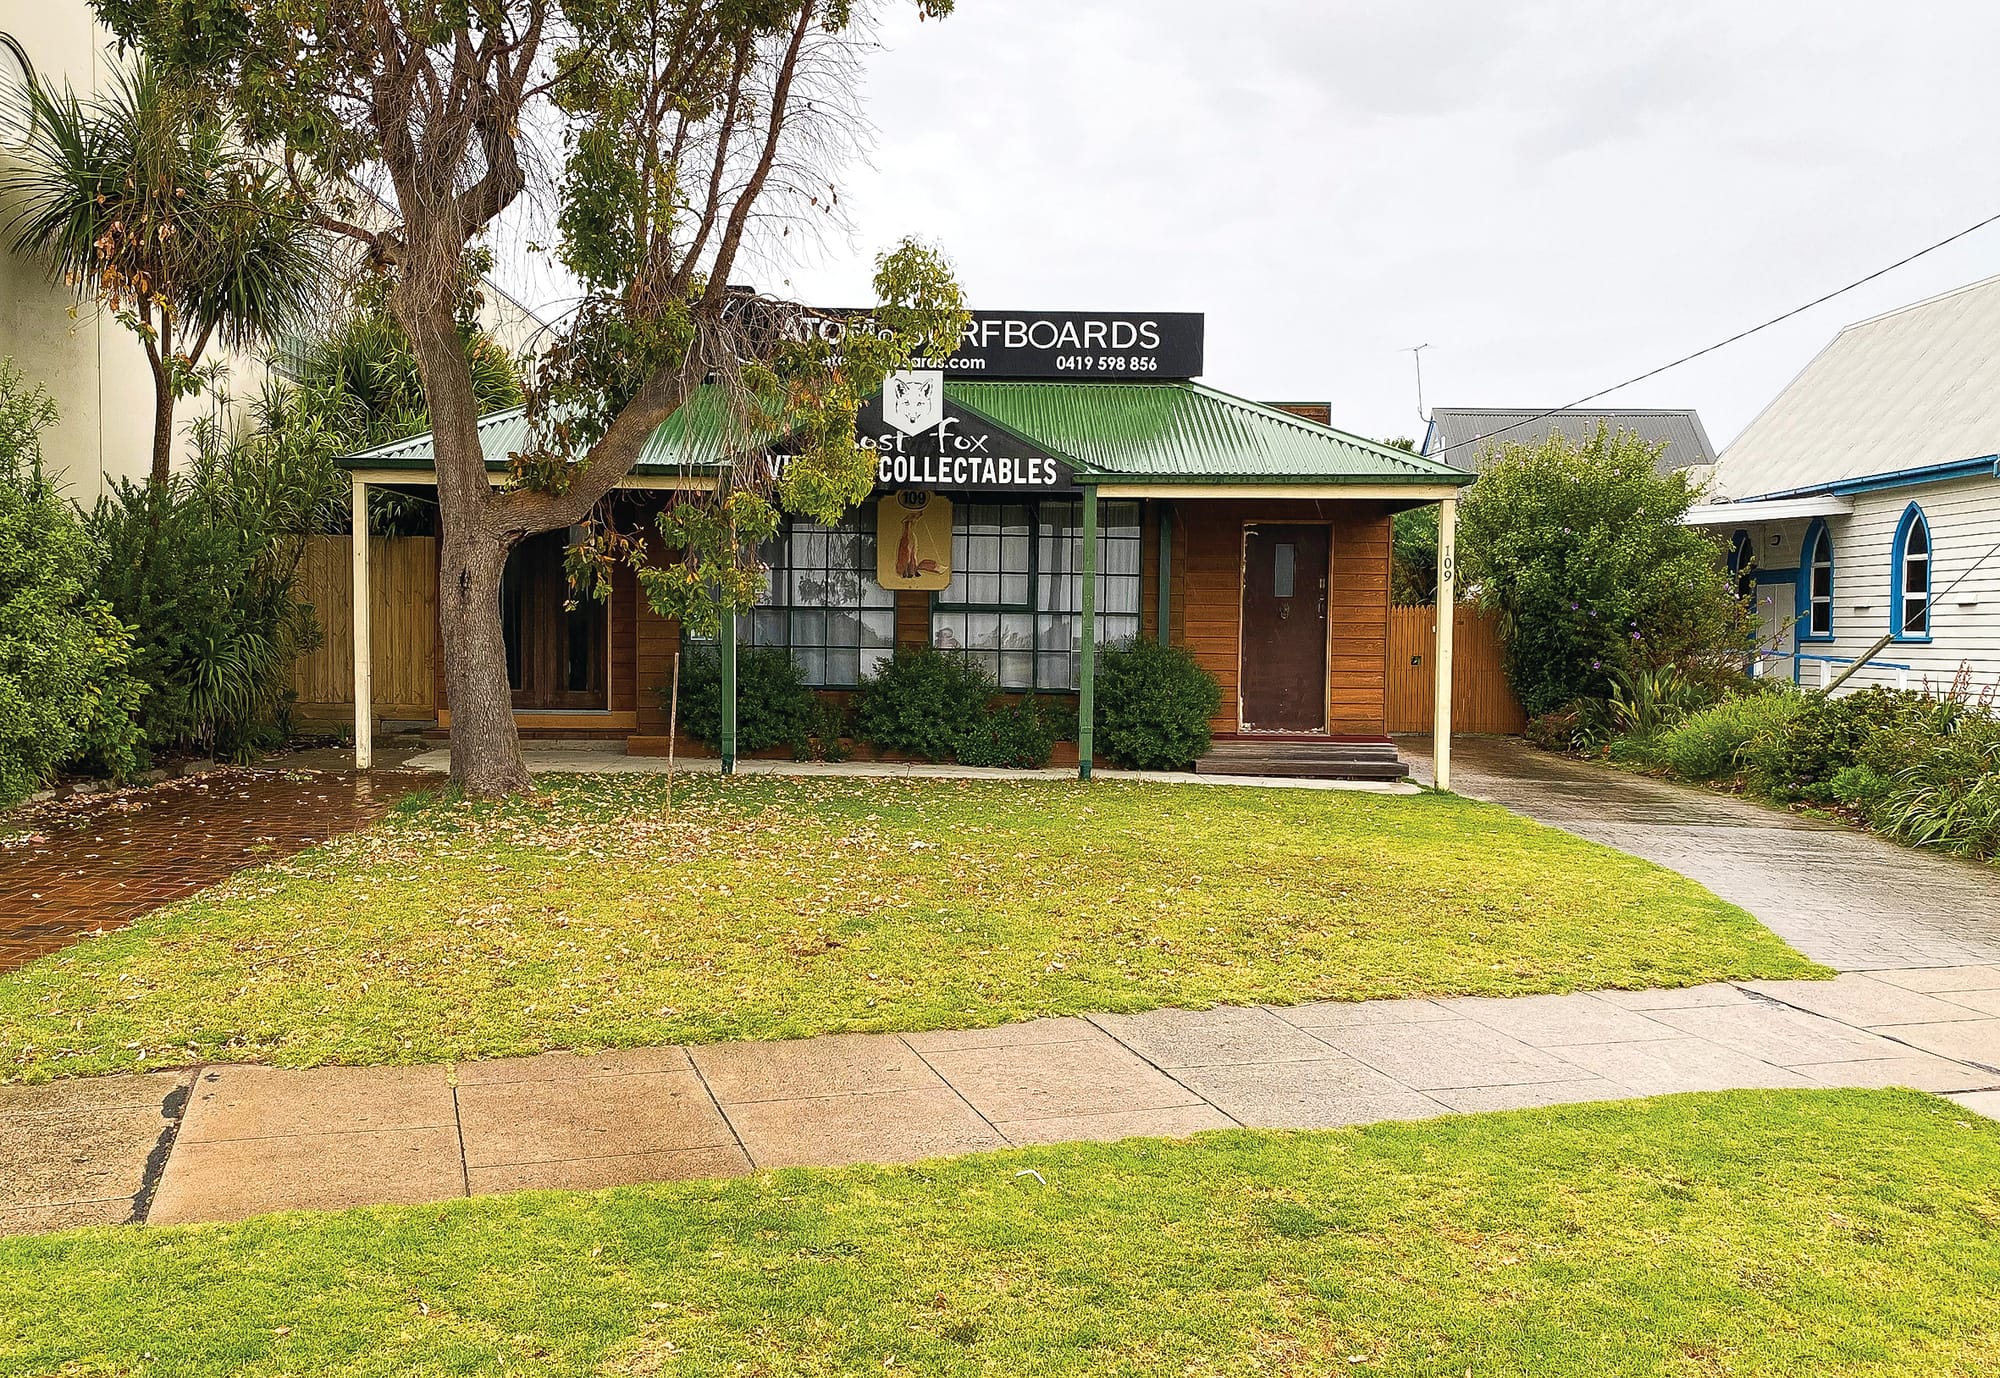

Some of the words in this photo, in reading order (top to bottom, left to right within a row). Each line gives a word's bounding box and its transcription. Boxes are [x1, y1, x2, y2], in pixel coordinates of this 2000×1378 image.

[1056, 356, 1093, 371] 0419
[1098, 356, 1126, 371] 598
[1130, 357, 1157, 371] 856
[855, 431, 911, 453] ost
[878, 456, 1057, 484] COLLECTABLES
[903, 491, 927, 504] 109
[1444, 545, 1452, 582] 109
